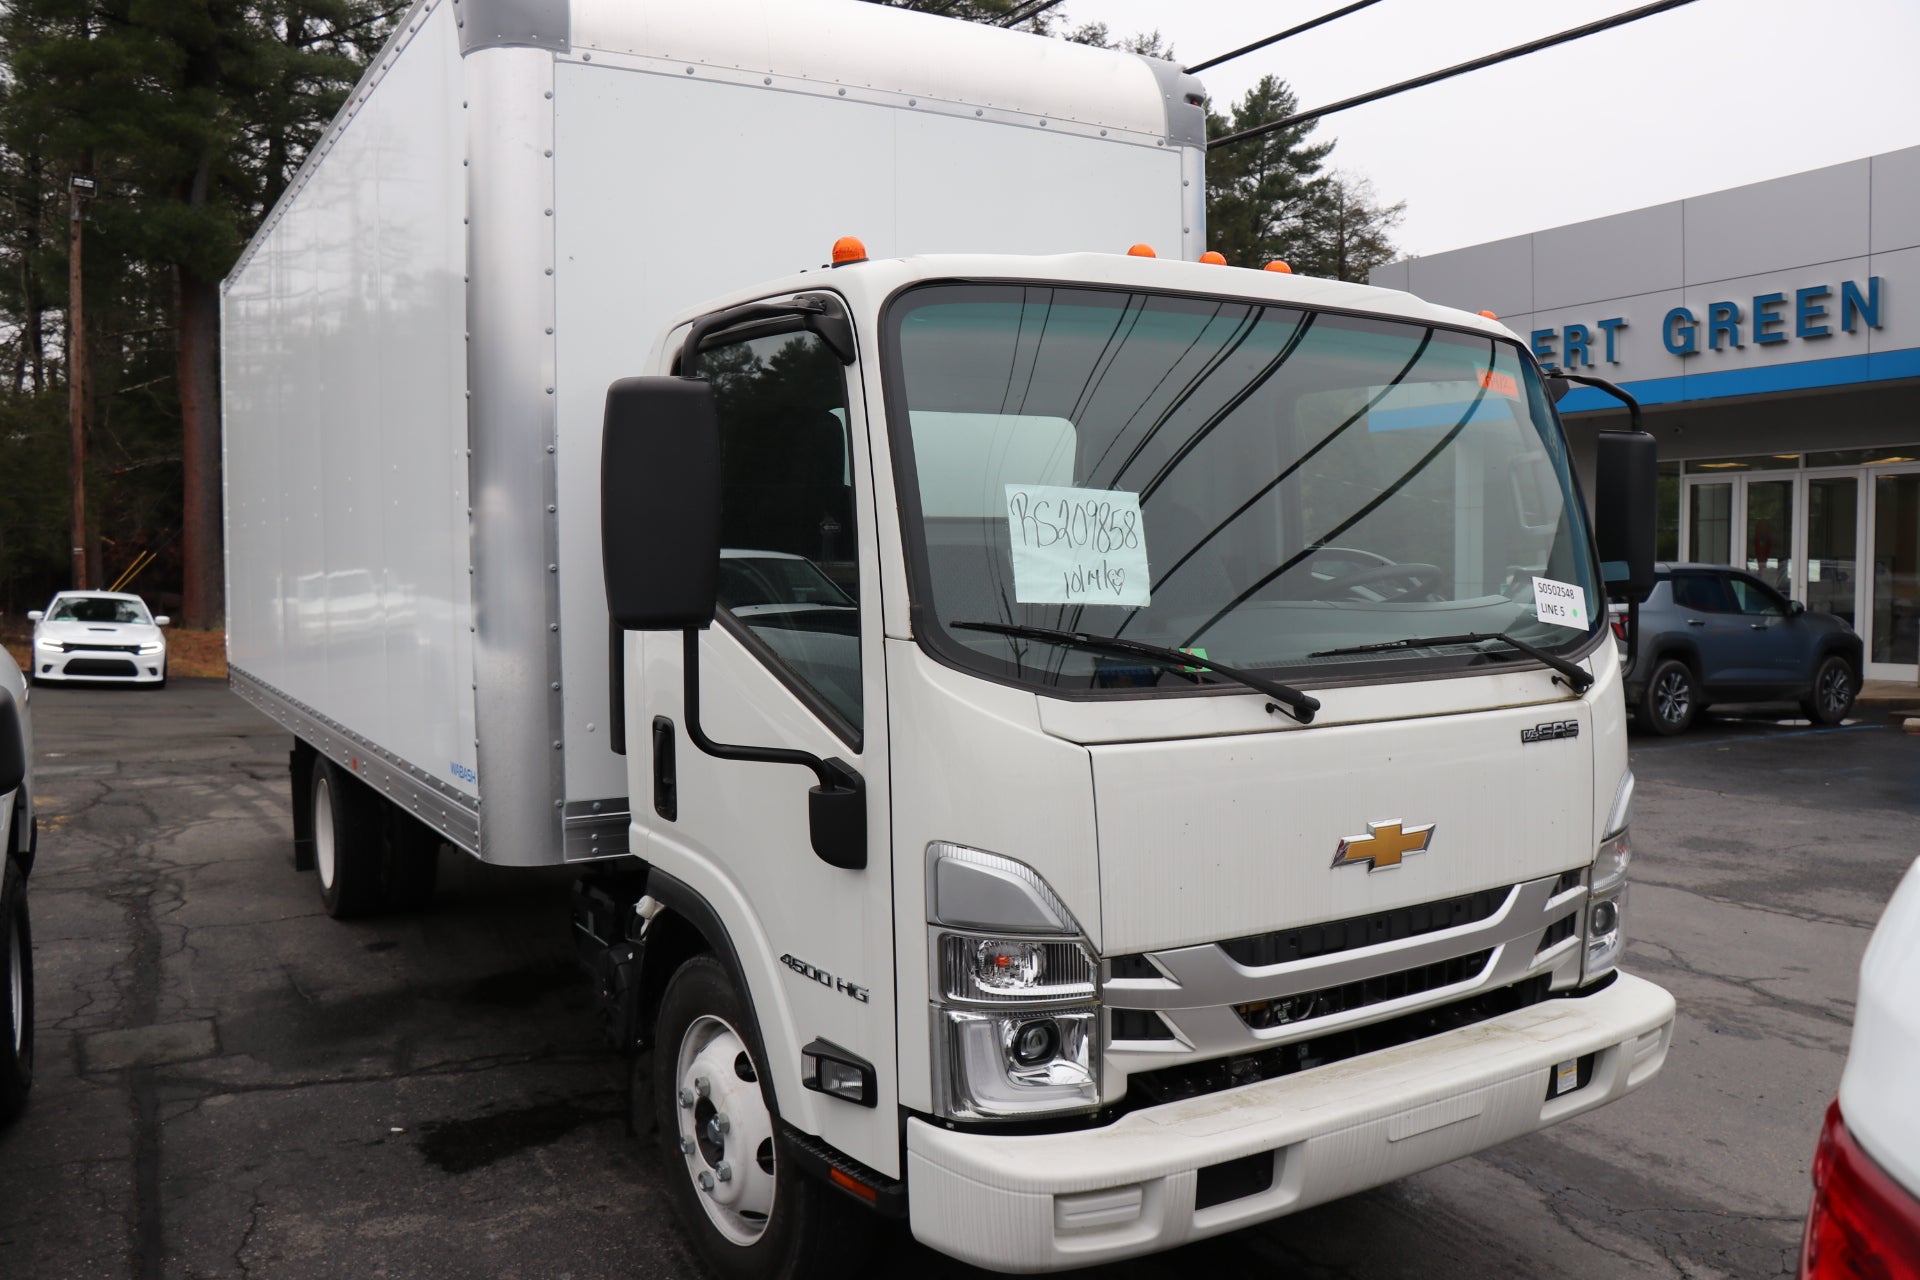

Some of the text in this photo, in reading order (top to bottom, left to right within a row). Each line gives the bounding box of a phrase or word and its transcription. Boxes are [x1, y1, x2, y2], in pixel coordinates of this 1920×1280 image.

[1662, 276, 1881, 356] GREEN
[1537, 582, 1575, 600] S0502548
[1540, 603, 1566, 617] LINE 5
[780, 953, 870, 1004] 4500 HG
